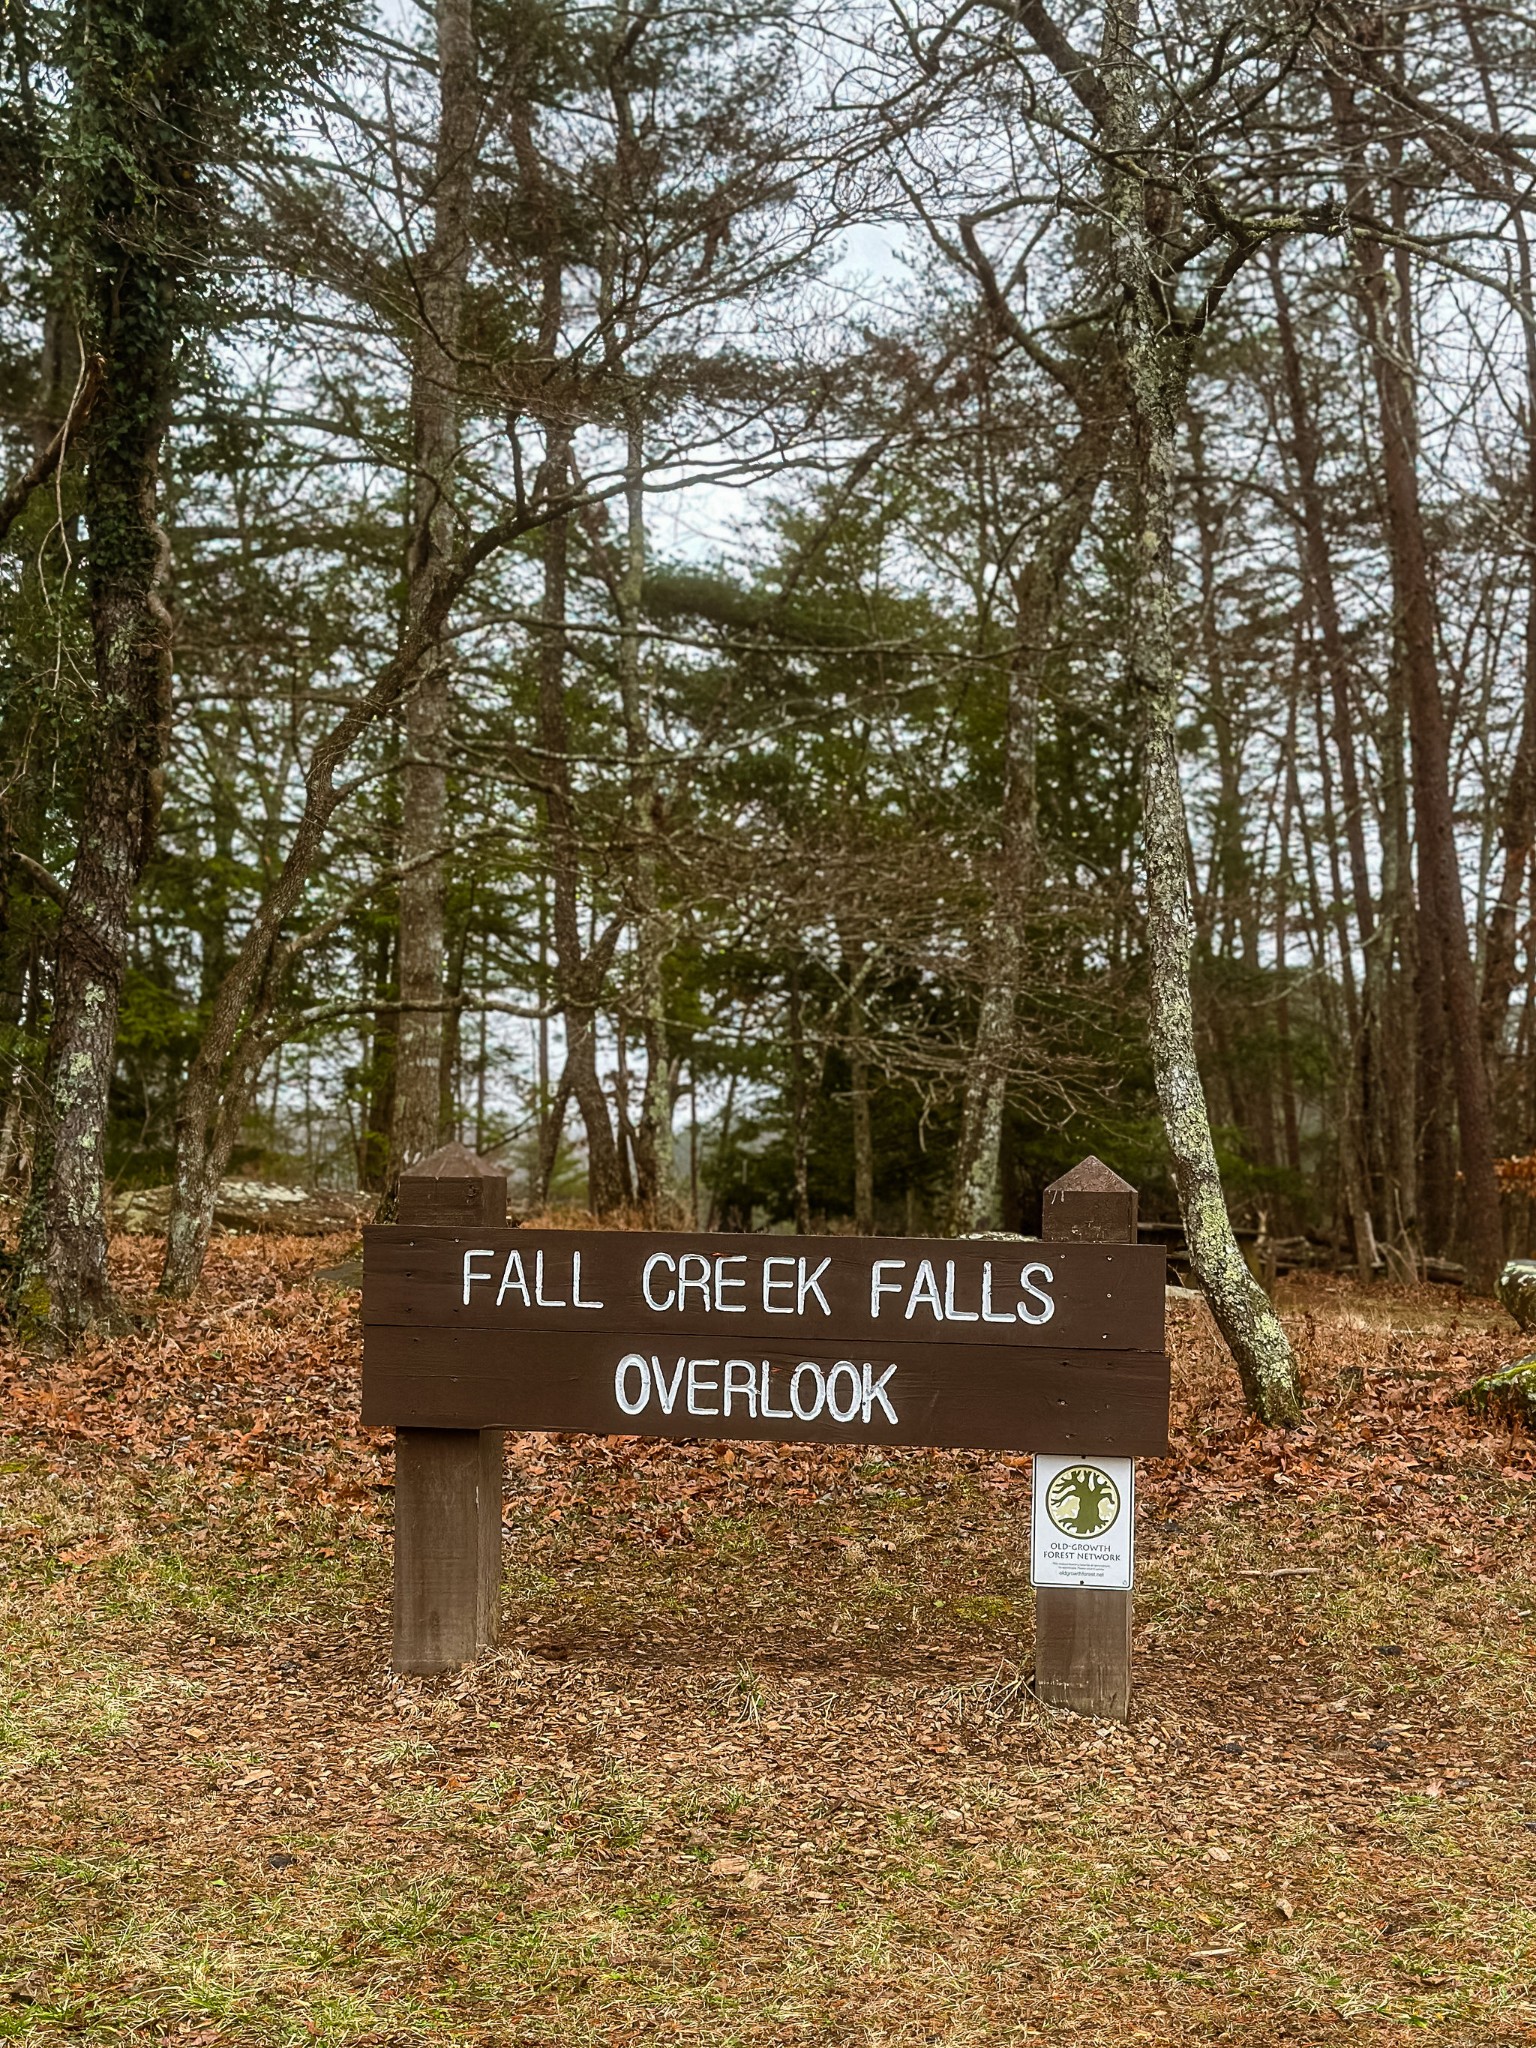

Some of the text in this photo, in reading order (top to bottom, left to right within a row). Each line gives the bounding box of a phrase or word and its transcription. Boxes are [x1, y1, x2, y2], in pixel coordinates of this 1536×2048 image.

[462, 1249, 1055, 1325] FALL CREEK FALLS
[614, 1353, 899, 1425] OVERLOOK
[1043, 1551, 1121, 1561] FOREST NETWORK
[1050, 1542, 1111, 1552] OLD-GROWTH
